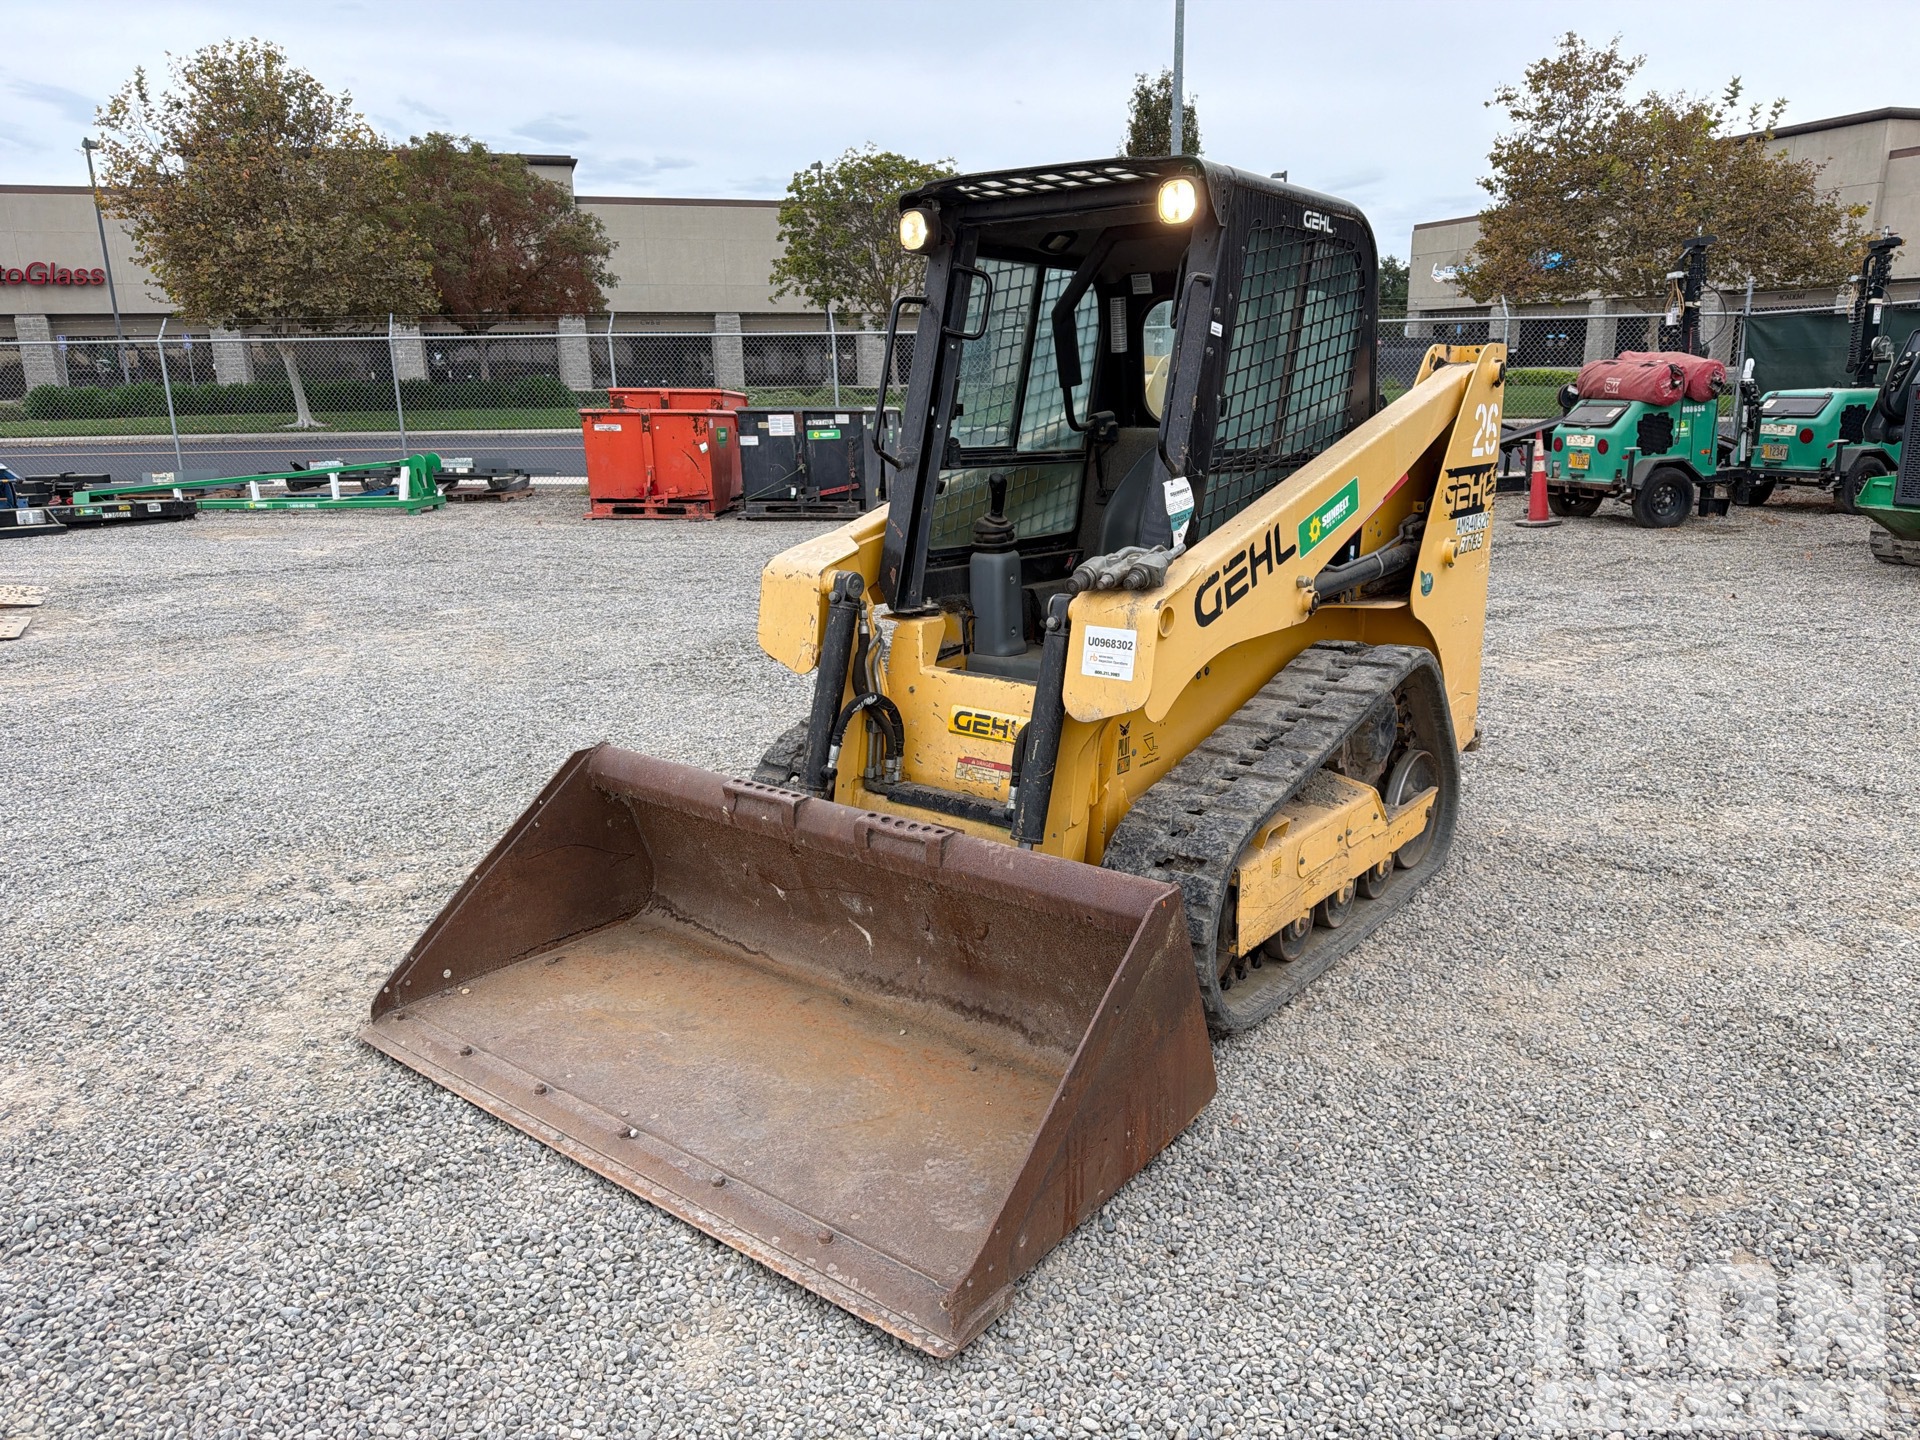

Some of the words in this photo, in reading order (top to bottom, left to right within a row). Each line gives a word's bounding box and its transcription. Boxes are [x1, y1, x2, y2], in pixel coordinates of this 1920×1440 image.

[1303, 210, 1334, 234] GEHL
[1471, 402, 1499, 457] 26
[1321, 494, 1350, 528] SUNBELT
[1326, 510, 1346, 530] RENTALS
[1194, 522, 1297, 628] GEHL
[1088, 636, 1133, 651] U0968302
